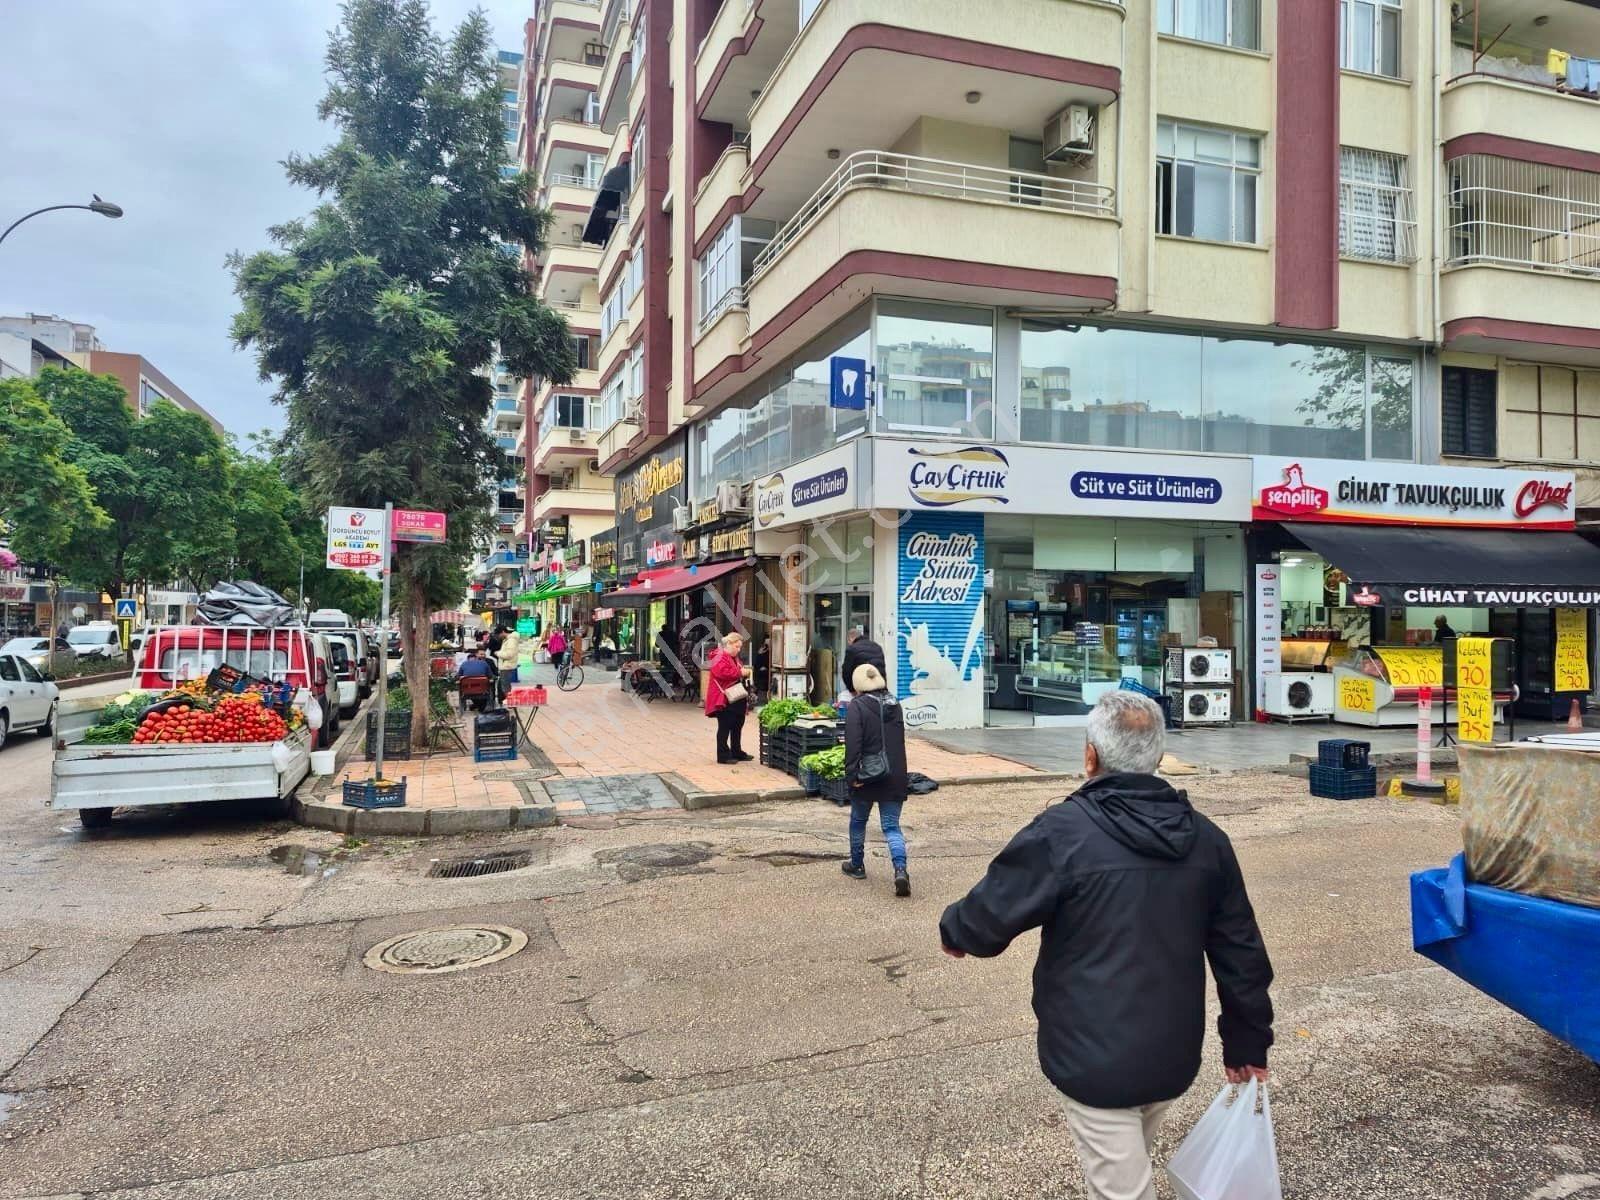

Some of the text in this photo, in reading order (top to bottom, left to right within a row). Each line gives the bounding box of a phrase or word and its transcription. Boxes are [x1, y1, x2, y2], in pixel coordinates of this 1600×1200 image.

[910, 462, 1006, 490] ÇayÇiftlik
[794, 472, 845, 503] Süt ve Süt Ürünleri
[1080, 477, 1214, 499] Süt ve Süt Ürünleri
[1338, 476, 1505, 511] CİHAT TAVUKÇULUK
[1515, 480, 1572, 517] Cihat
[1268, 489, 1322, 509] şenpiliç
[909, 534, 975, 557] Günlük
[923, 558, 975, 579] Sütün
[903, 580, 968, 601] Adresi
[1404, 588, 1467, 602] CİHAT
